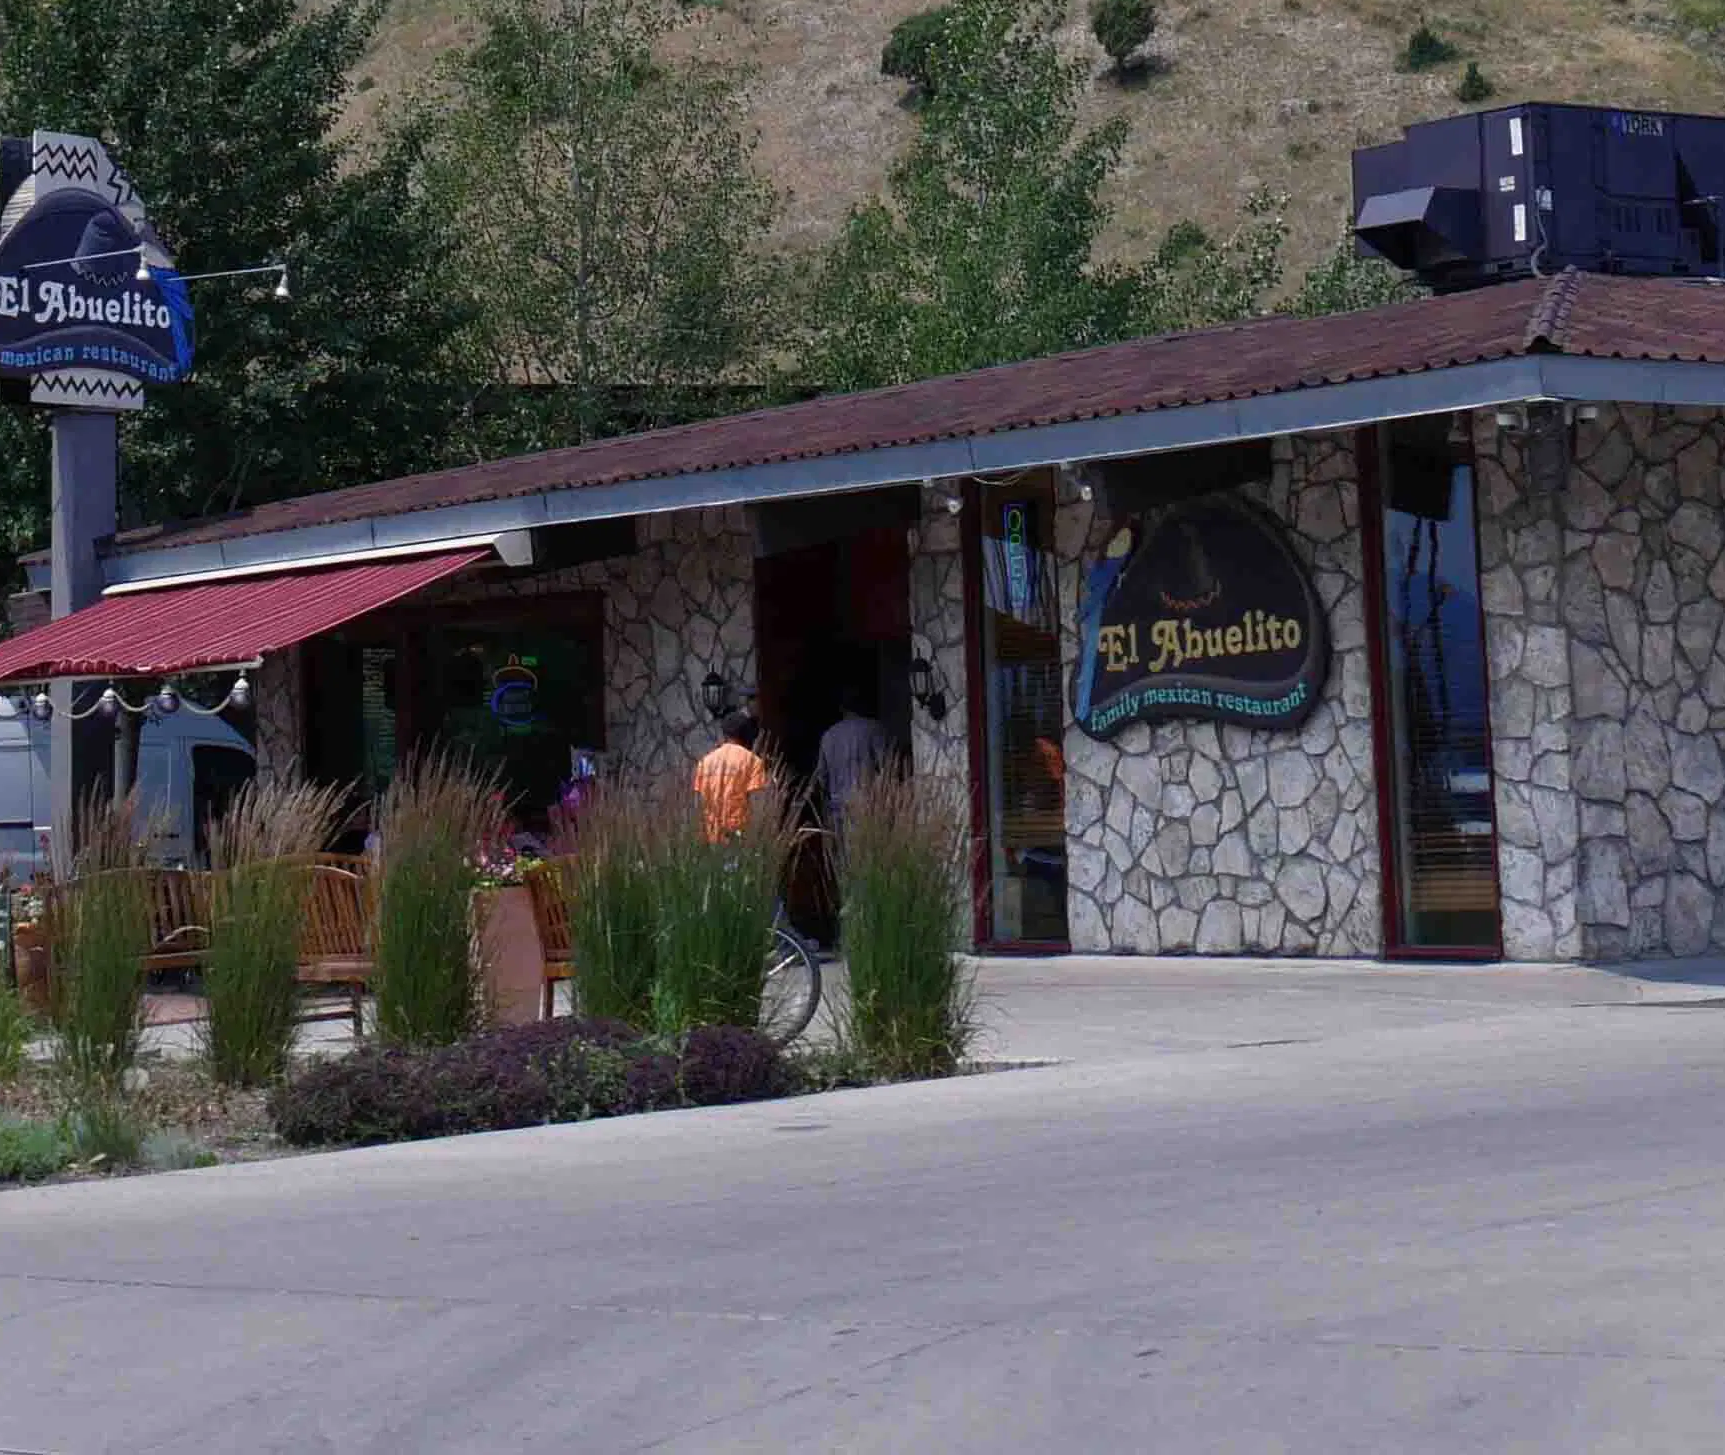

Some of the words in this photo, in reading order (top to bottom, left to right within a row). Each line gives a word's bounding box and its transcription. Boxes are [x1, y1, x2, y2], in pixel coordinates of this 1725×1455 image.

[34, 281, 171, 328] Abuelito
[0, 346, 74, 366] mexican
[82, 344, 177, 381] restaurant
[1097, 623, 1139, 672] El
[1148, 609, 1302, 673] Abuelito
[1090, 694, 1140, 732] family
[1142, 687, 1212, 705] mexican
[1216, 679, 1308, 715] restaurant
